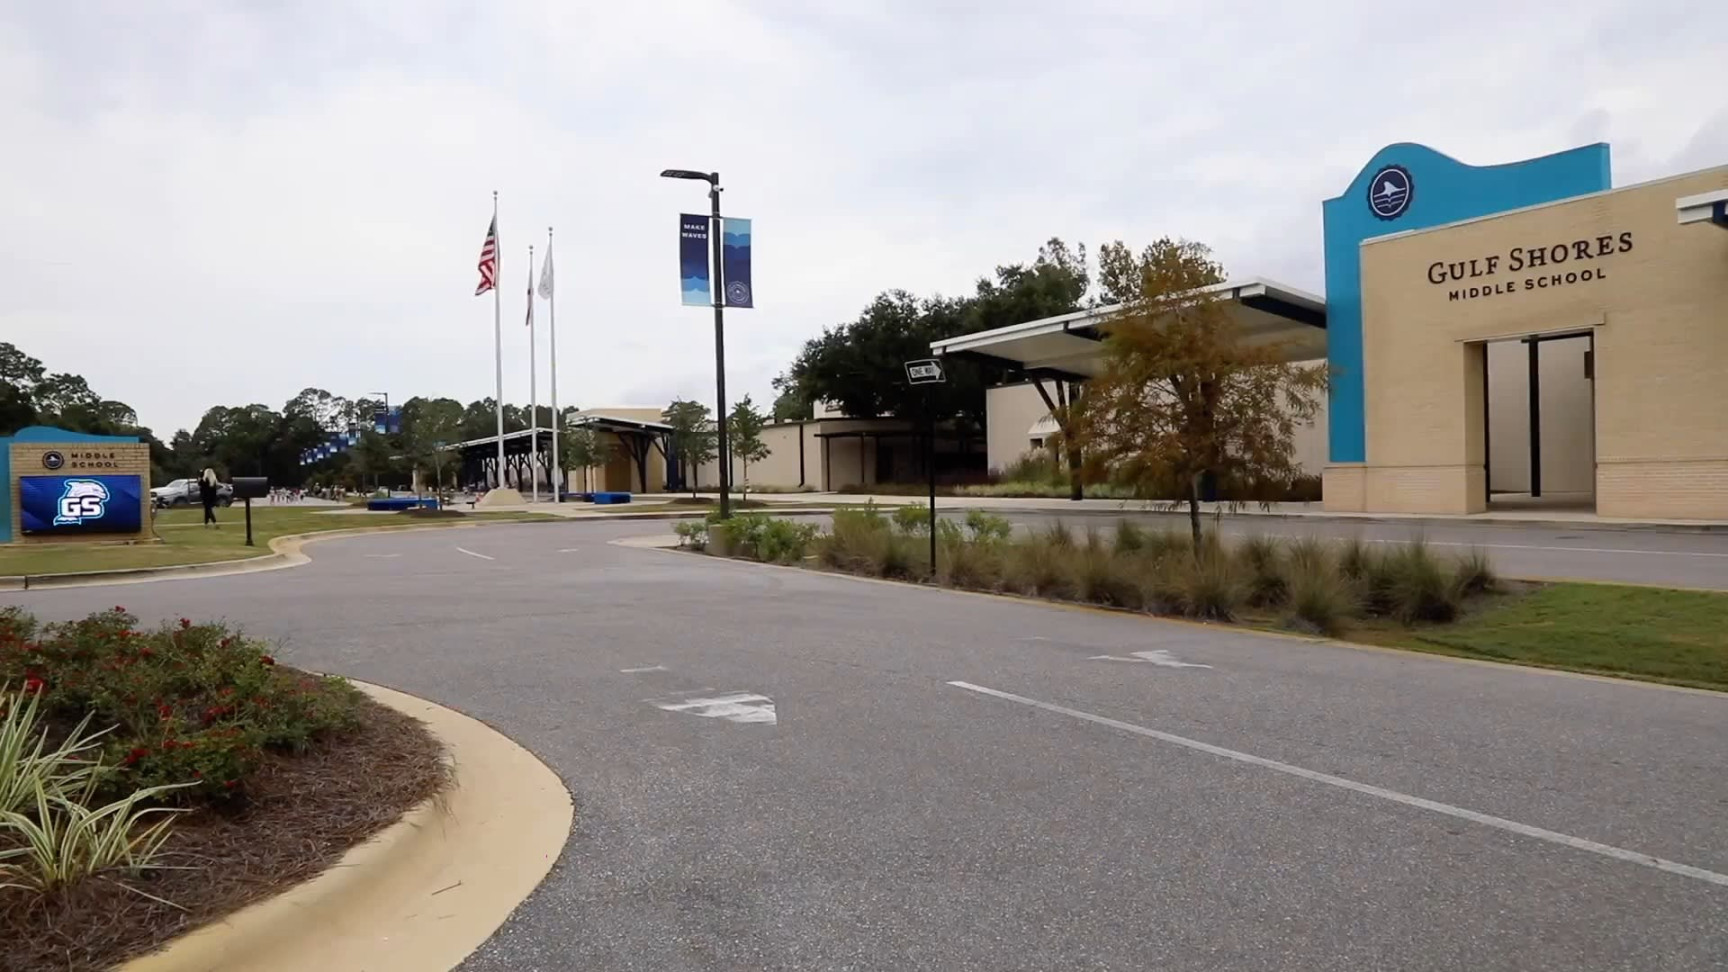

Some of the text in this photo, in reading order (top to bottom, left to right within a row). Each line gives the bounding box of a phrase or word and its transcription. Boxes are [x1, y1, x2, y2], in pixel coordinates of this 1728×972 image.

[1428, 231, 1634, 285] GULF SHORES
[1448, 267, 1607, 302] MIDDLE SCHOOL
[911, 367, 924, 377] ONE
[71, 452, 115, 460] MIDDLE
[61, 497, 101, 517] GS
